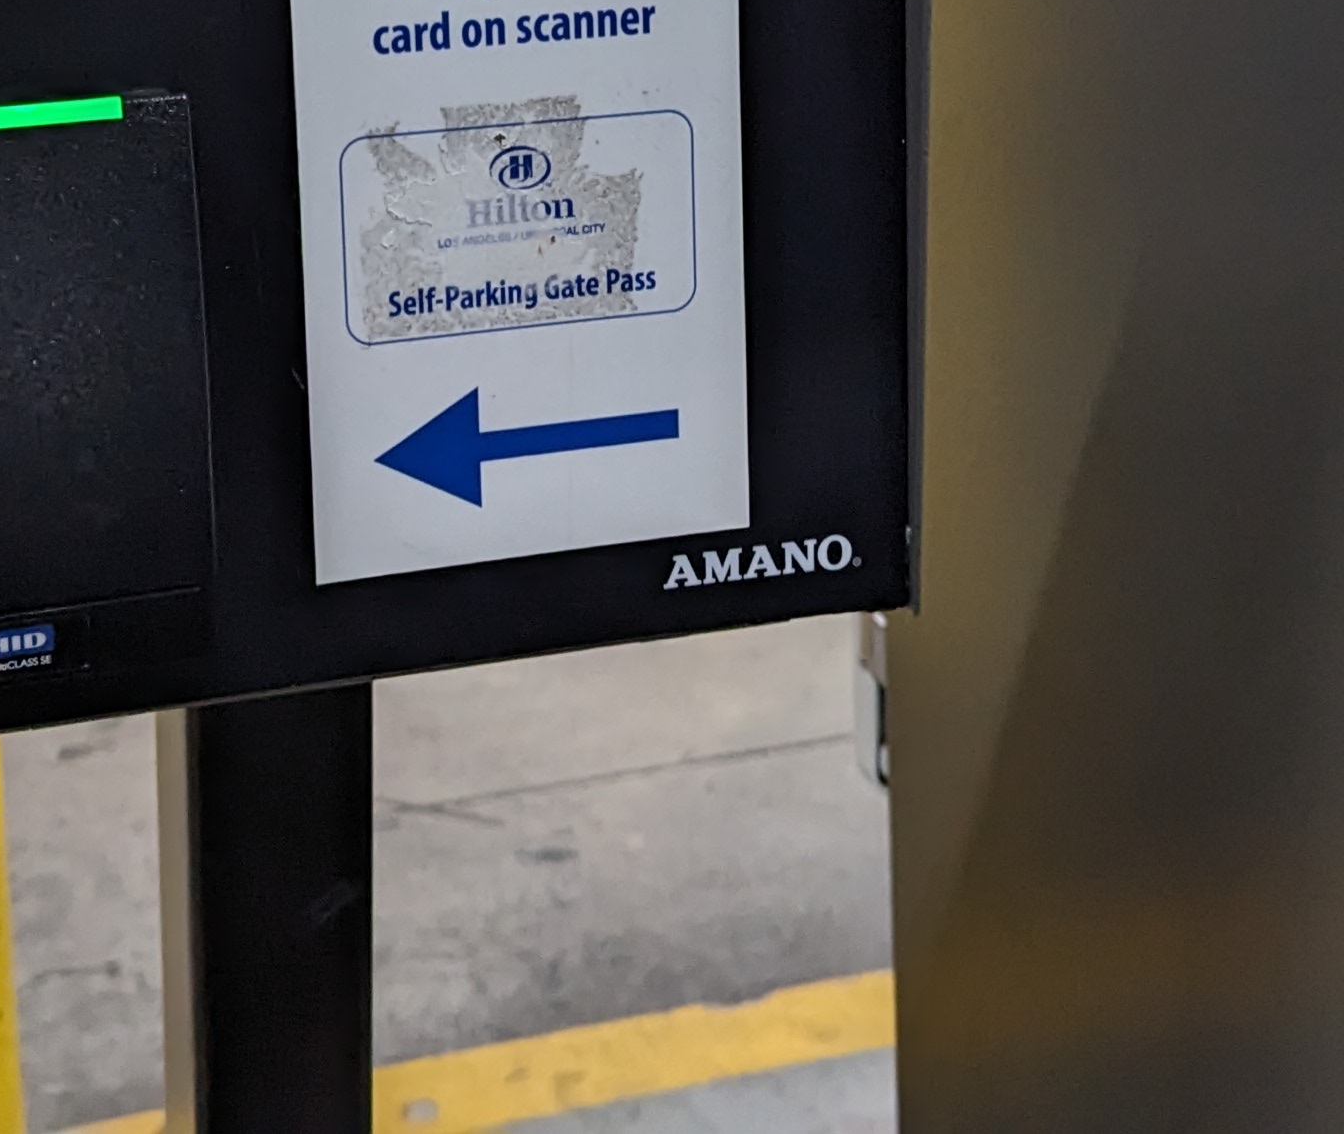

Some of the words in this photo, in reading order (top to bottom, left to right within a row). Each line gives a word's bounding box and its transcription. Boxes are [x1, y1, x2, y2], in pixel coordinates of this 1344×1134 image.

[372, 11, 451, 55] card
[461, 16, 506, 48] on
[516, 5, 656, 44] scanner
[466, 193, 576, 228] Hilton
[582, 223, 607, 233] CITY
[388, 278, 538, 318] Self-Parking
[545, 271, 600, 300] Gate
[606, 269, 657, 295] Pass
